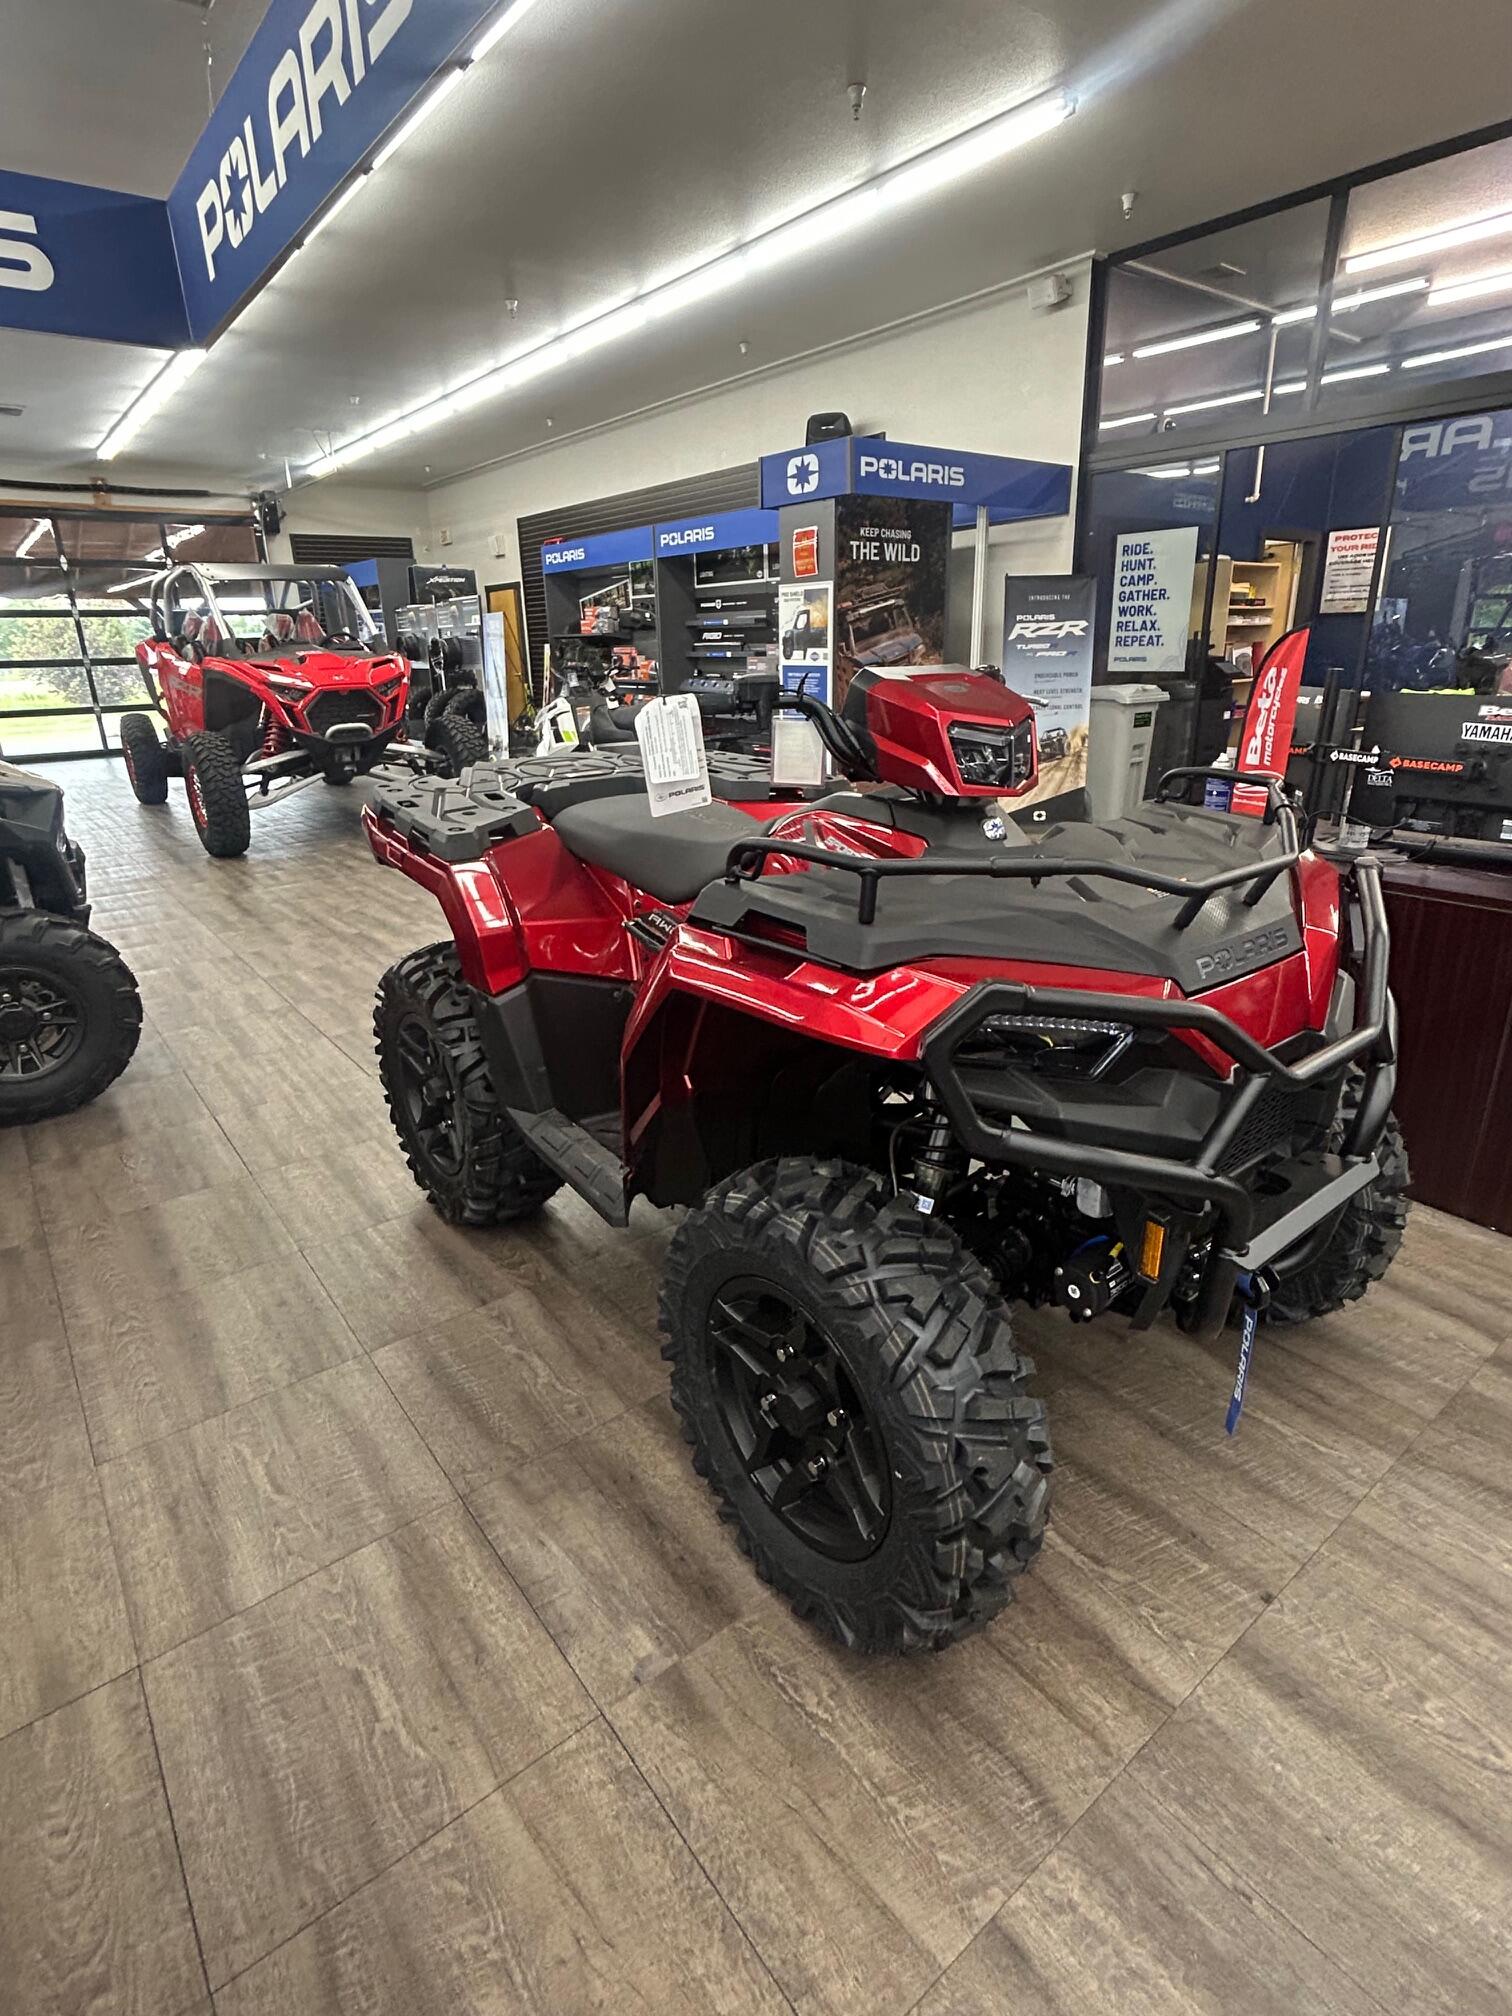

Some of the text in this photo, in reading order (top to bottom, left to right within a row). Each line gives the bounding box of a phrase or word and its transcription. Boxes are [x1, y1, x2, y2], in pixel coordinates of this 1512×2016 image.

[861, 456, 965, 487] POLARIS
[660, 526, 715, 547] POLARIS
[860, 527, 912, 540] KEEP CHASING
[546, 548, 585, 565] POLARIS
[850, 540, 920, 562] THE WILD
[1122, 542, 1154, 556] RIDE.
[1121, 557, 1156, 572] HUNT.
[1120, 573, 1158, 588] CAMP.
[1118, 588, 1170, 602] GATHER.
[1118, 604, 1157, 617] WORK.
[1008, 620, 1089, 640] RZR
[1116, 620, 1161, 632] RELAX.
[1115, 635, 1165, 648] REPEAT.
[1246, 667, 1277, 765] Beta
[1263, 667, 1288, 766] motorcycles
[1464, 723, 1512, 742] YAMAH
[1339, 753, 1379, 764] BASECAMP
[1402, 760, 1464, 773] BASECAMP
[668, 784, 705, 798] POLARIS
[1195, 927, 1288, 979] POLARIS
[1234, 1315, 1254, 1402] POLARIS
